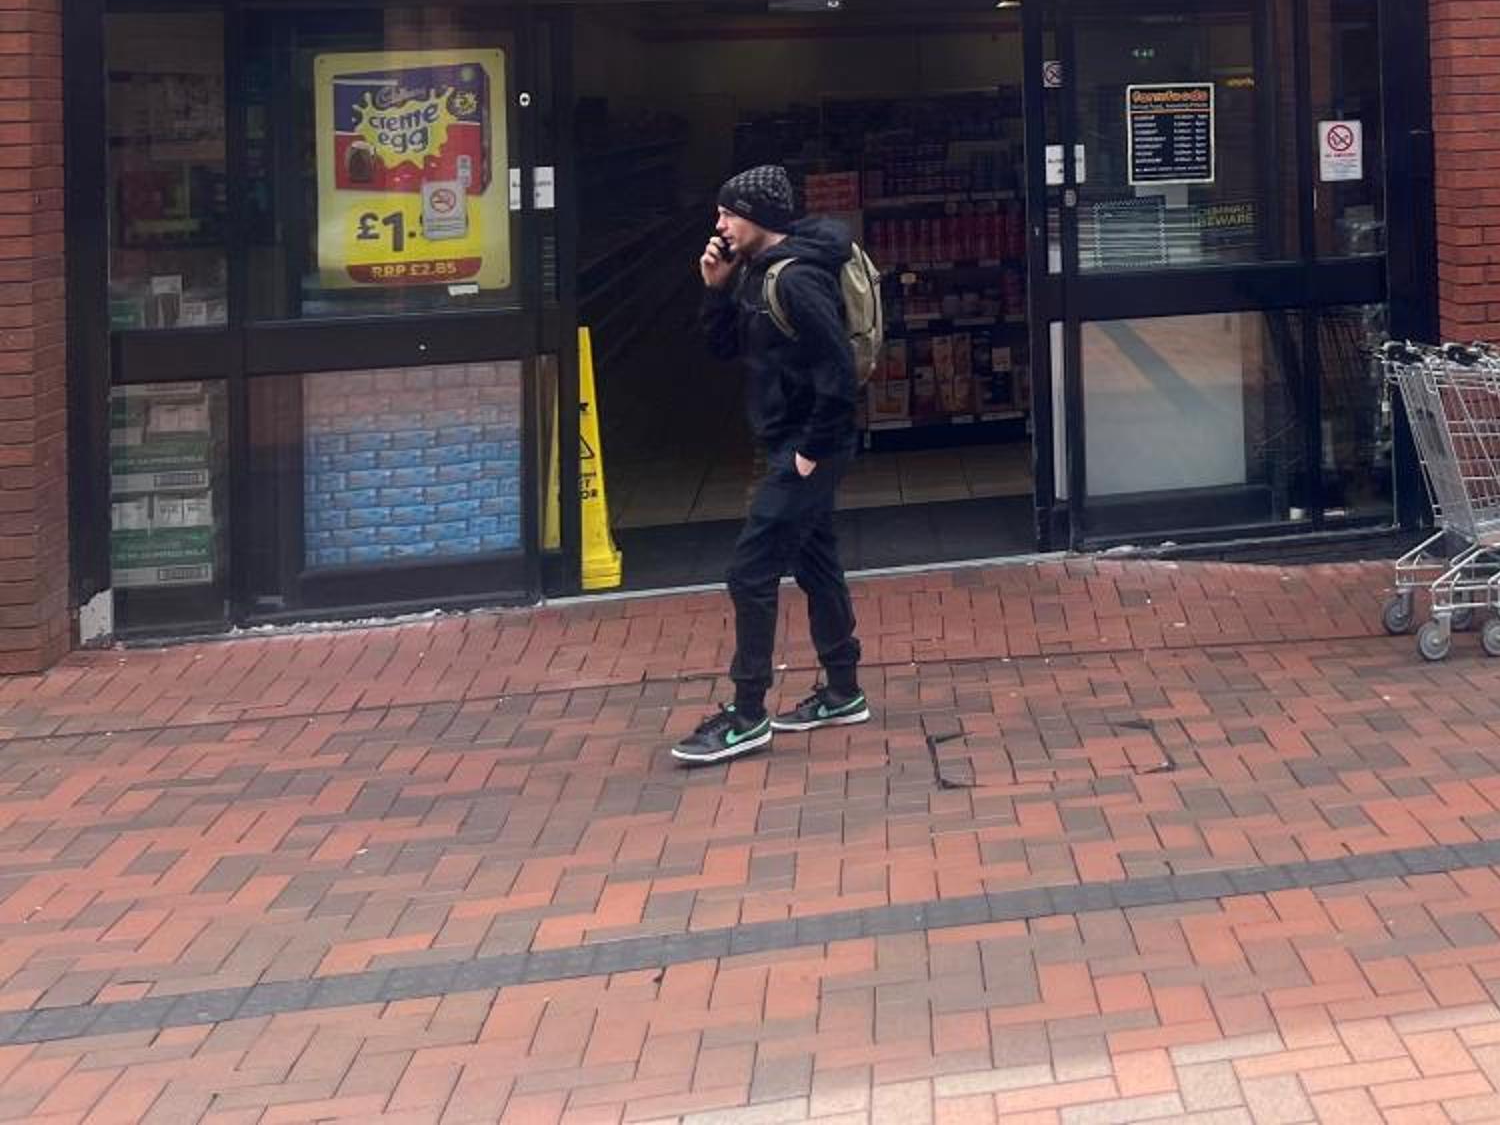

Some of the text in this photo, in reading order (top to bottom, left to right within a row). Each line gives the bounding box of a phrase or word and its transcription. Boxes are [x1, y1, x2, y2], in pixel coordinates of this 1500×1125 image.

[369, 103, 438, 131] creme
[378, 128, 429, 154] egg
[1199, 213, 1252, 227] BEWARE
[372, 262, 457, 278] RRP £2.85
